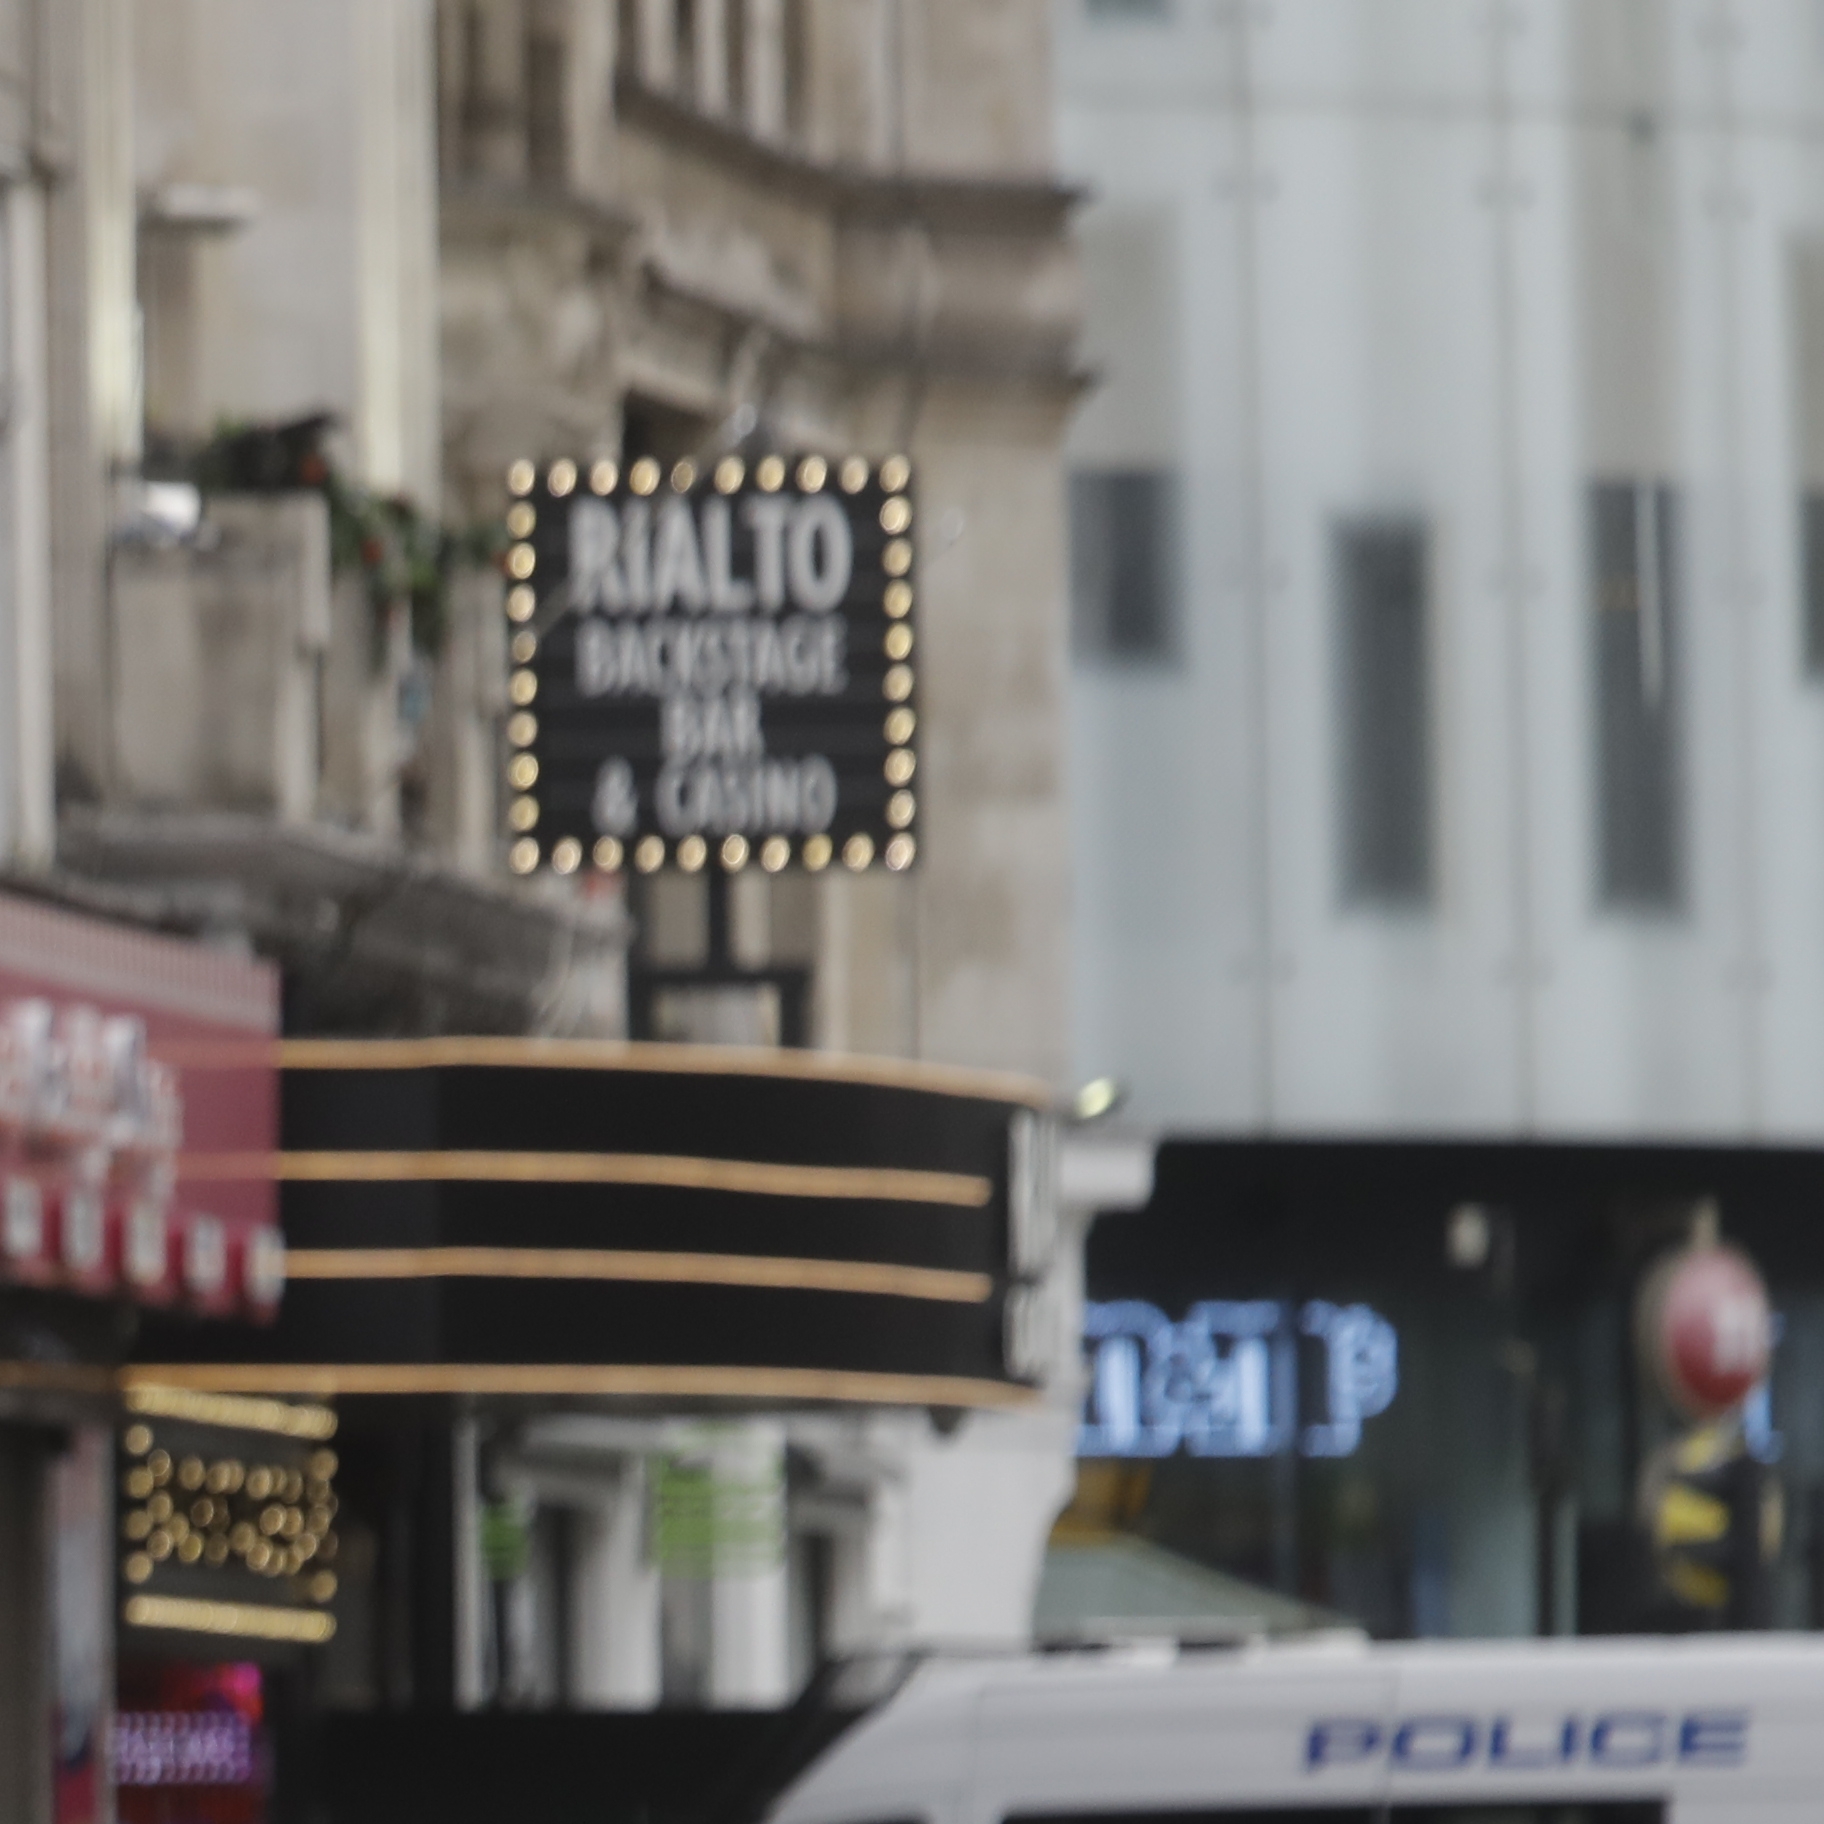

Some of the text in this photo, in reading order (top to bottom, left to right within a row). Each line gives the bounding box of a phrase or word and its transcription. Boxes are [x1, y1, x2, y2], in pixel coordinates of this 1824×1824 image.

[568, 495, 853, 612] RIALTO
[574, 612, 850, 696] BACKSTAGE
[657, 694, 764, 760] BAR
[656, 754, 839, 838] CASINO
[1301, 1707, 1750, 1775] POLICE
